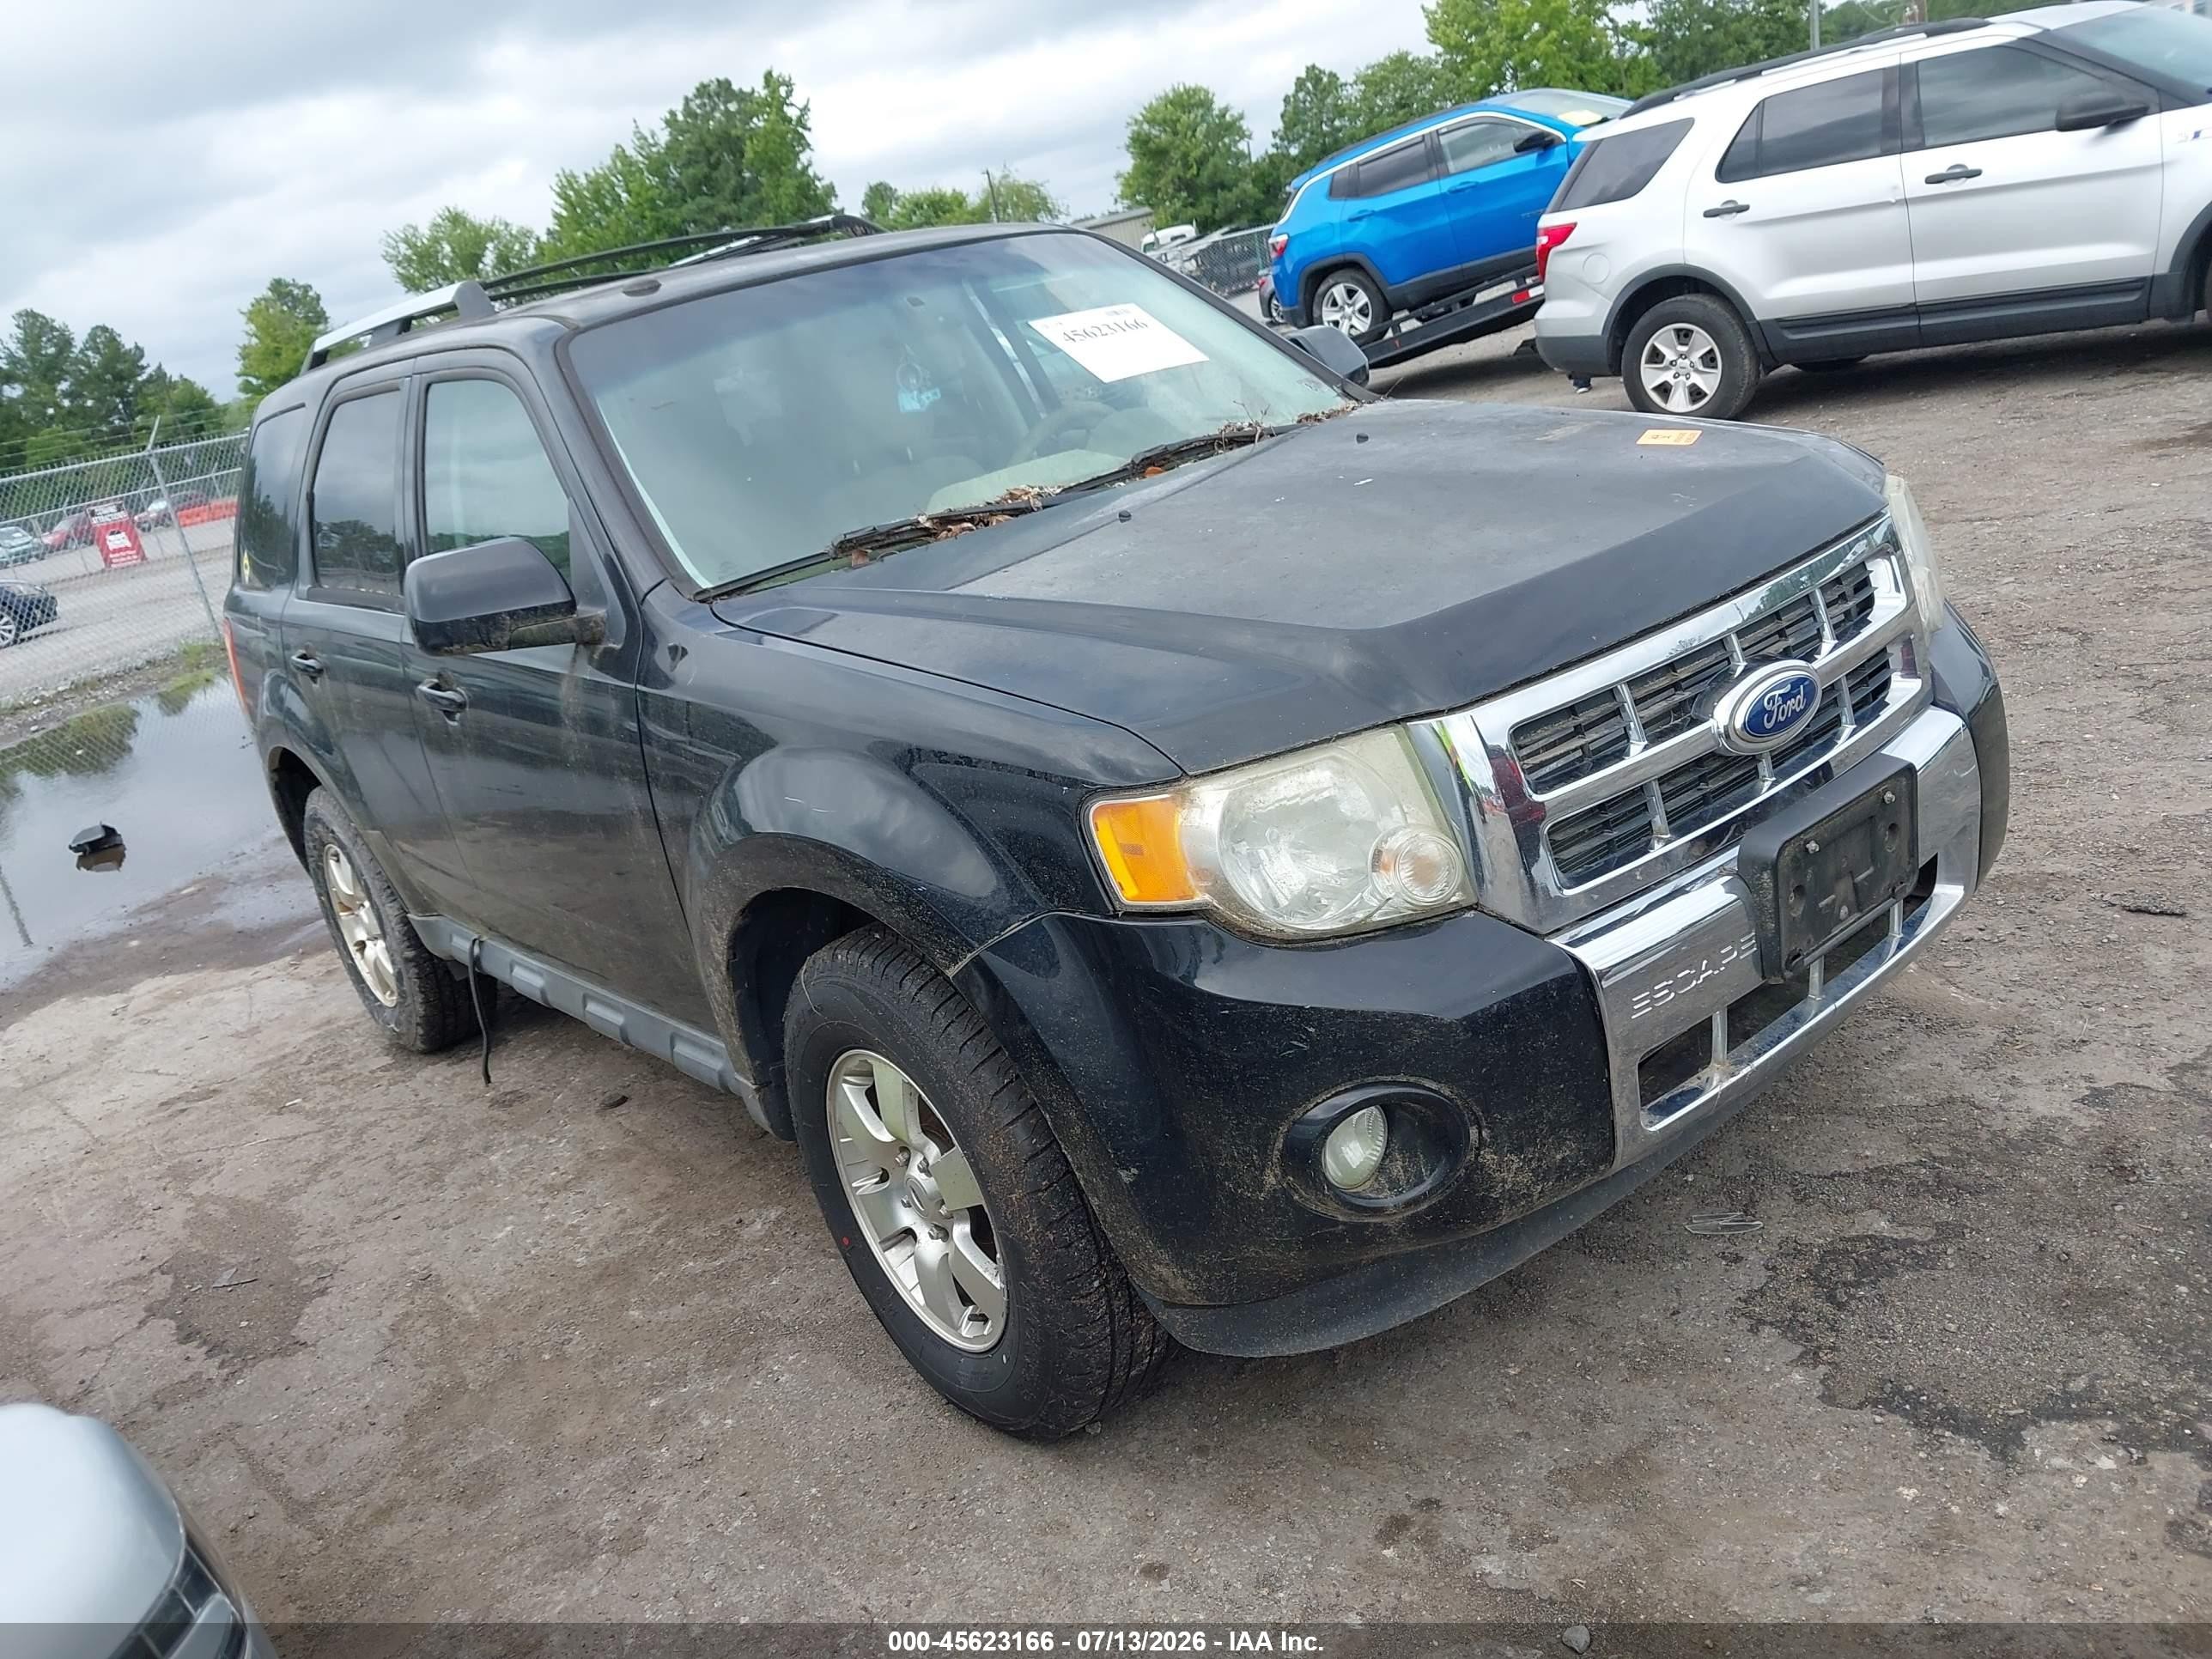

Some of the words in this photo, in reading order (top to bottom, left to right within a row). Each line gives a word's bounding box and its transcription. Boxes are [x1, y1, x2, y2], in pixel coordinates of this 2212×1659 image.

[1062, 318, 1149, 343] 45623166
[1763, 684, 1807, 729] Ford
[1631, 931, 1758, 1019] ESCAPE
